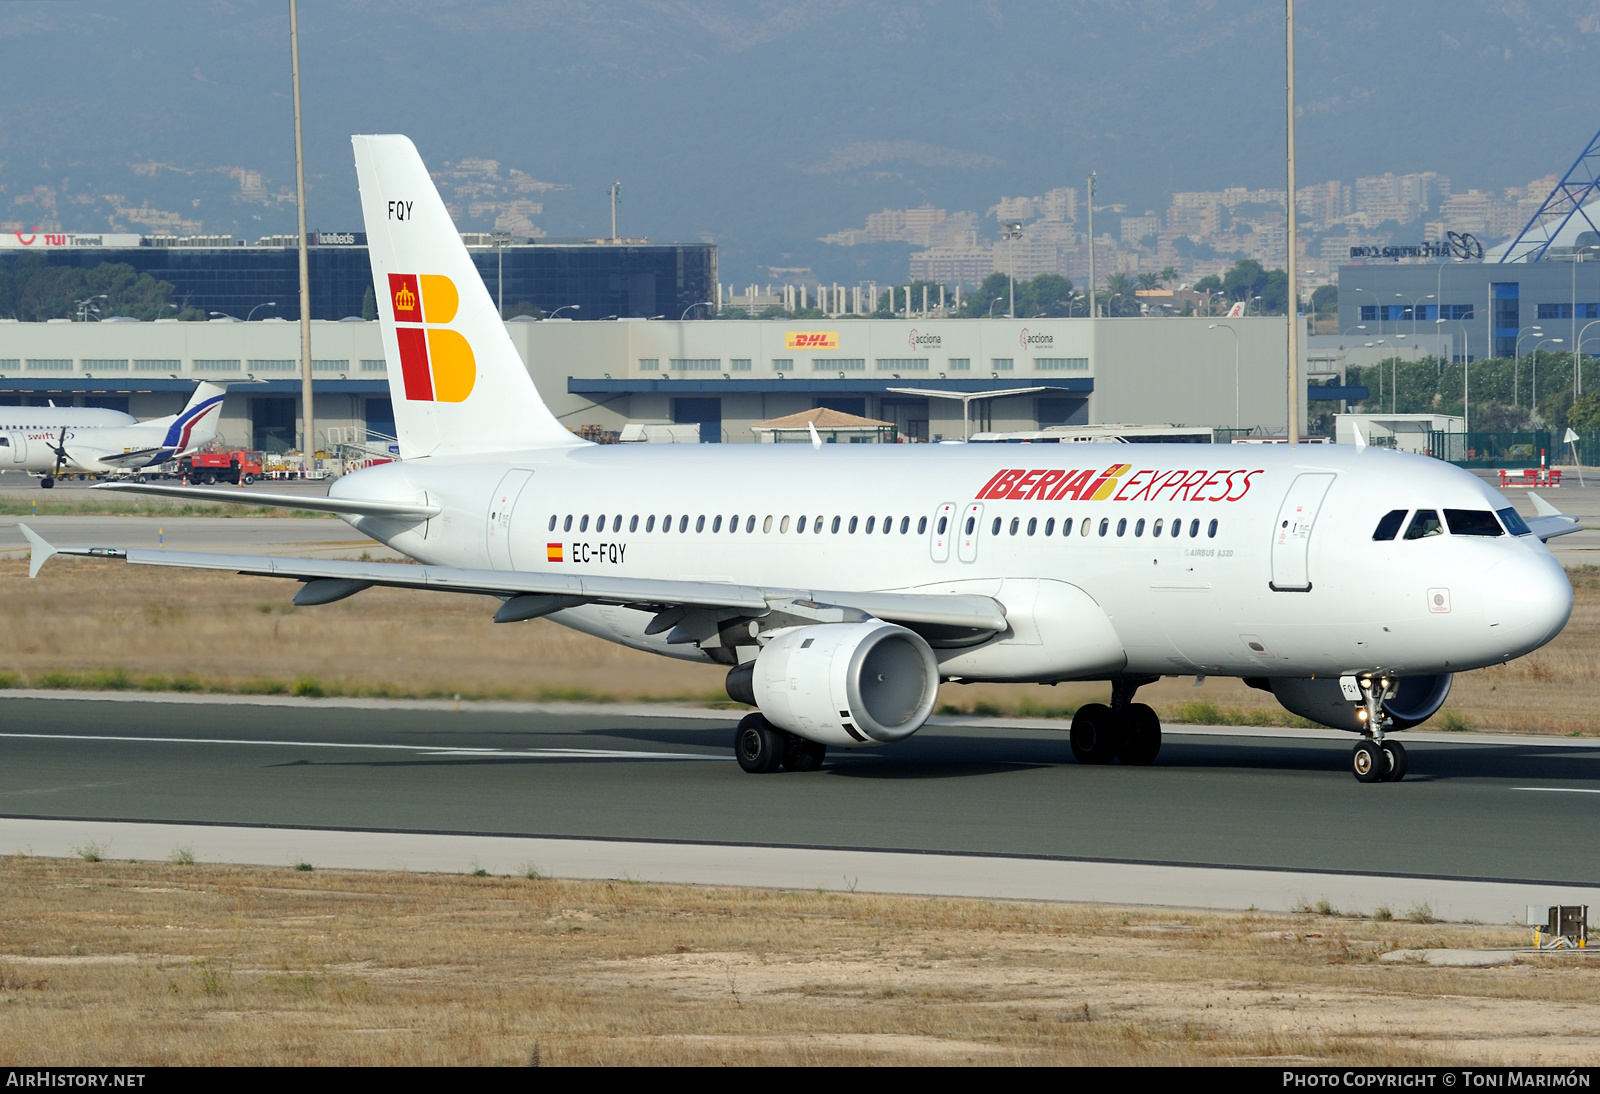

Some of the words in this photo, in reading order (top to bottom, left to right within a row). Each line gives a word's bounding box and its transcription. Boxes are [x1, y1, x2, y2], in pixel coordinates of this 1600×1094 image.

[388, 200, 414, 221] FQY
[44, 234, 66, 246] TUI
[67, 234, 103, 246] Travel
[319, 232, 354, 244] hotelbeds
[795, 334, 829, 347] DHL
[915, 333, 942, 344] acciona
[1027, 332, 1054, 344] acciona
[27, 432, 55, 440] swift
[975, 469, 1097, 501] IBERIA
[1112, 469, 1265, 502] EXPRESS
[572, 542, 627, 564] EC-FQY
[1190, 549, 1216, 557] AIRBUS
[1217, 549, 1234, 558] A320
[1342, 684, 1358, 693] FQY
